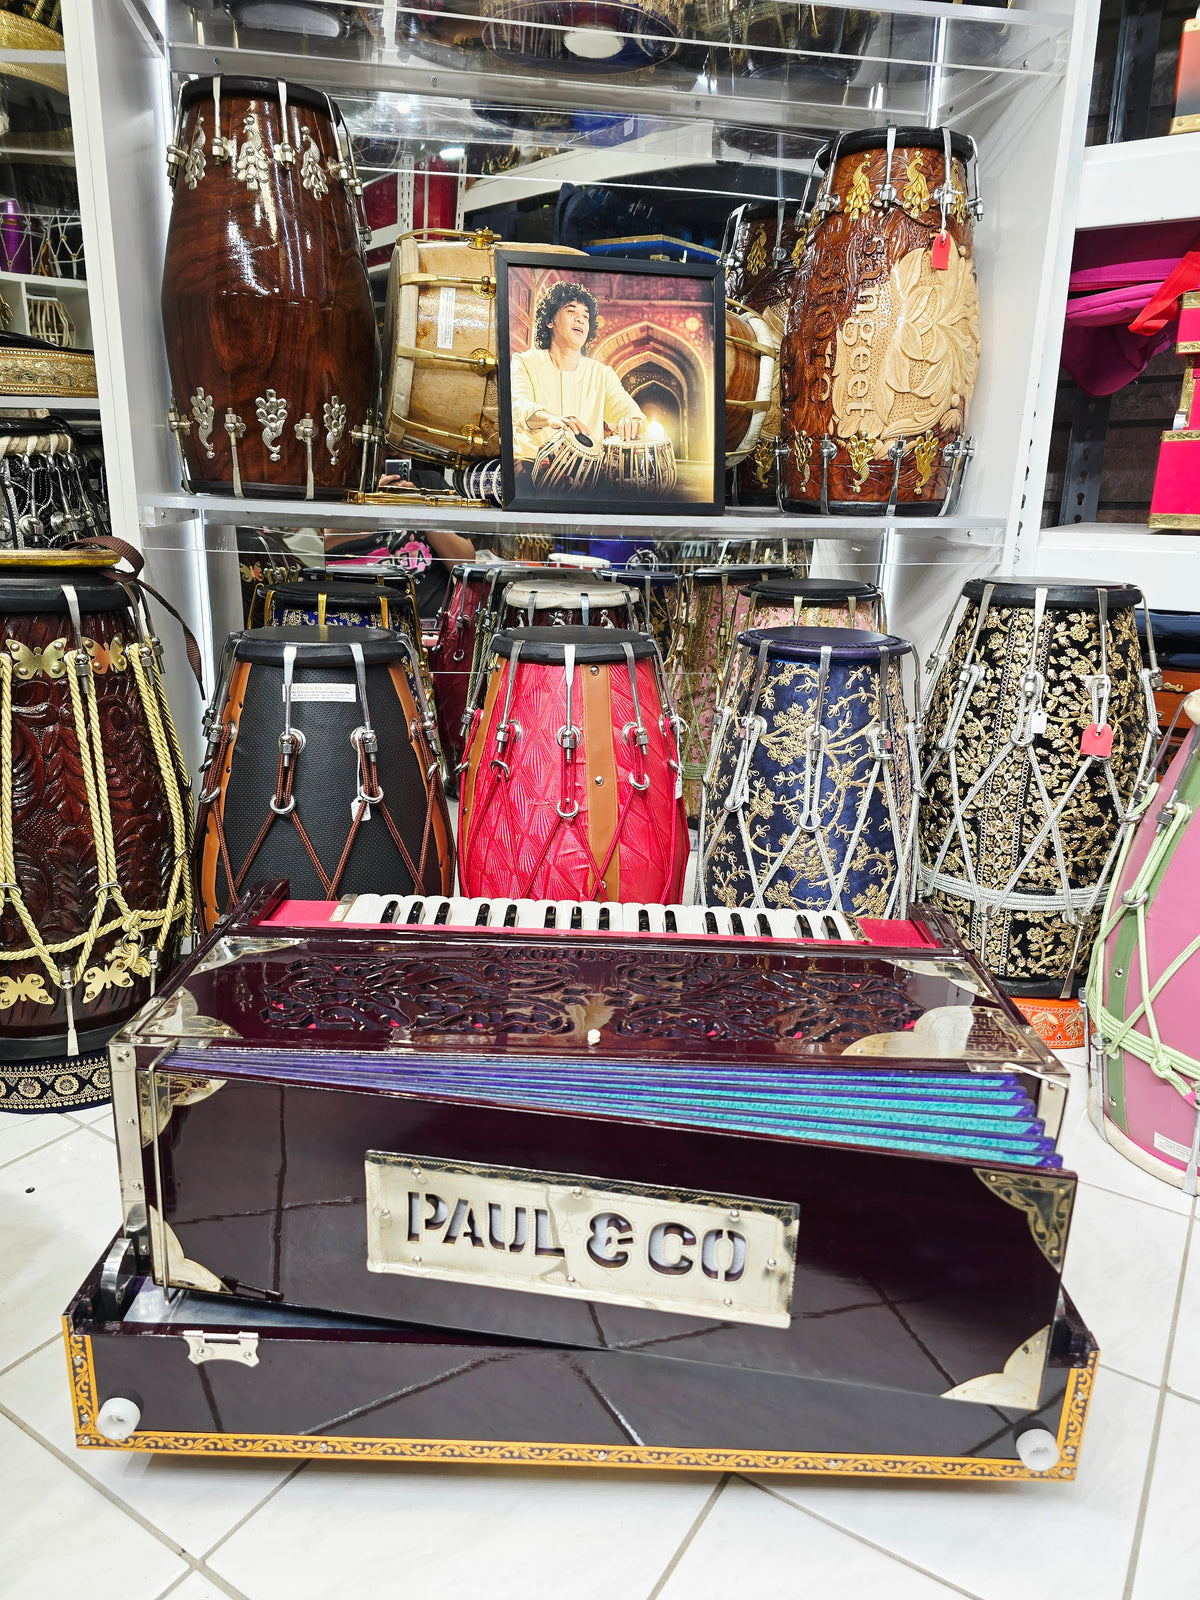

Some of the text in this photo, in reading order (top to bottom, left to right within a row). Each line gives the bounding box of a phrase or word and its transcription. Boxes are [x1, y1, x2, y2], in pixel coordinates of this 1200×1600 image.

[407, 1191, 565, 1257] PAUL
[587, 1212, 634, 1268] &
[649, 1222, 746, 1281] CO
